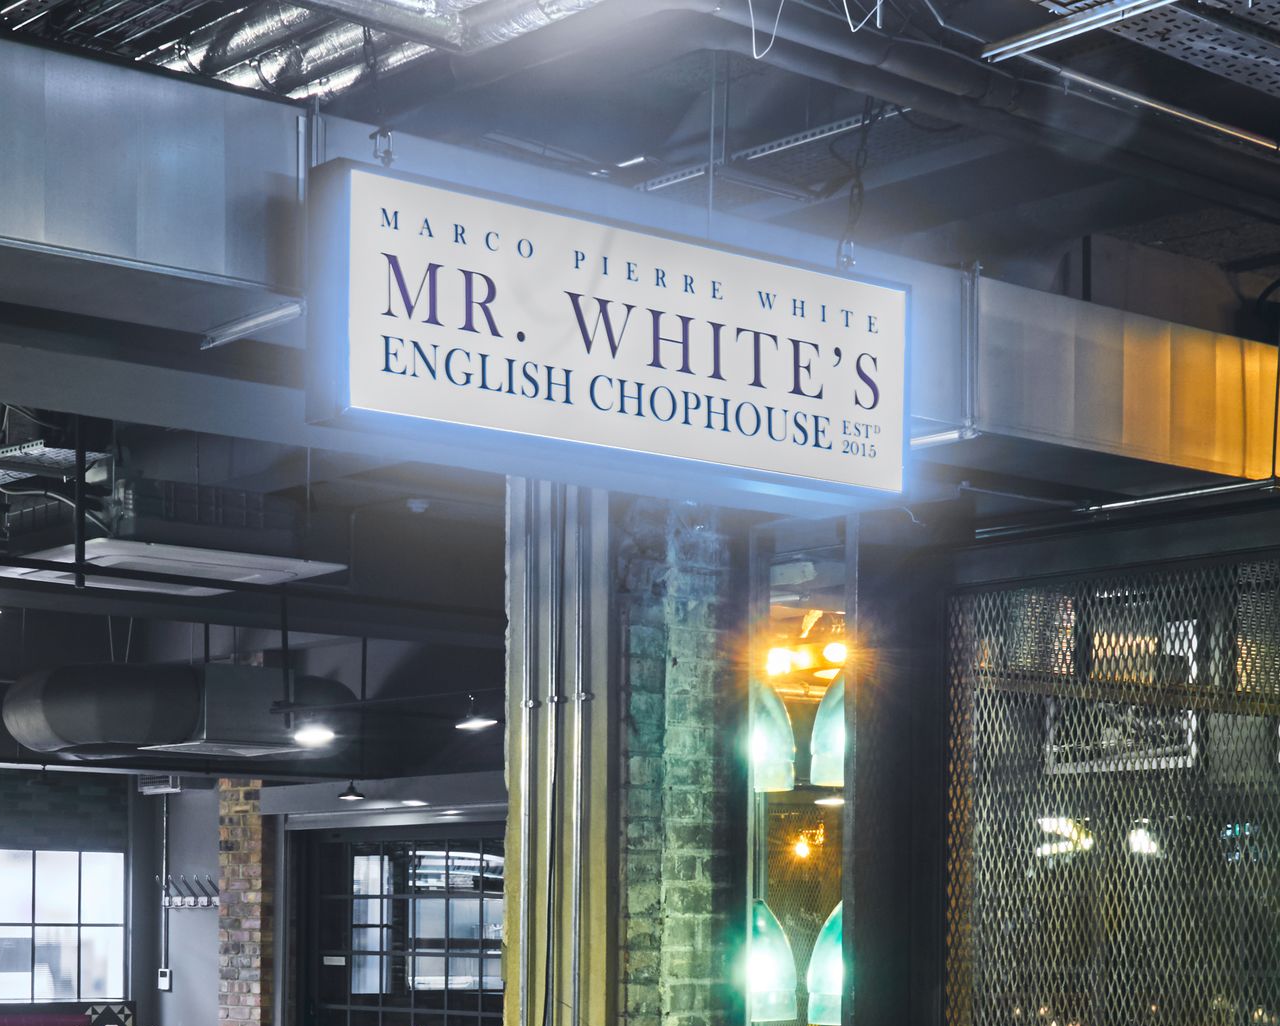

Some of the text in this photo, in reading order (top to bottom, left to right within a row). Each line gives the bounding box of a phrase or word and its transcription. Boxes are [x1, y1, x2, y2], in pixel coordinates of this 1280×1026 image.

[380, 207, 879, 334] MARCO PIERRE WHITE
[380, 252, 880, 410] MR. WHITE'S
[380, 335, 833, 450] ENGLISH CHOPHOUSE
[842, 440, 877, 458] 2015
